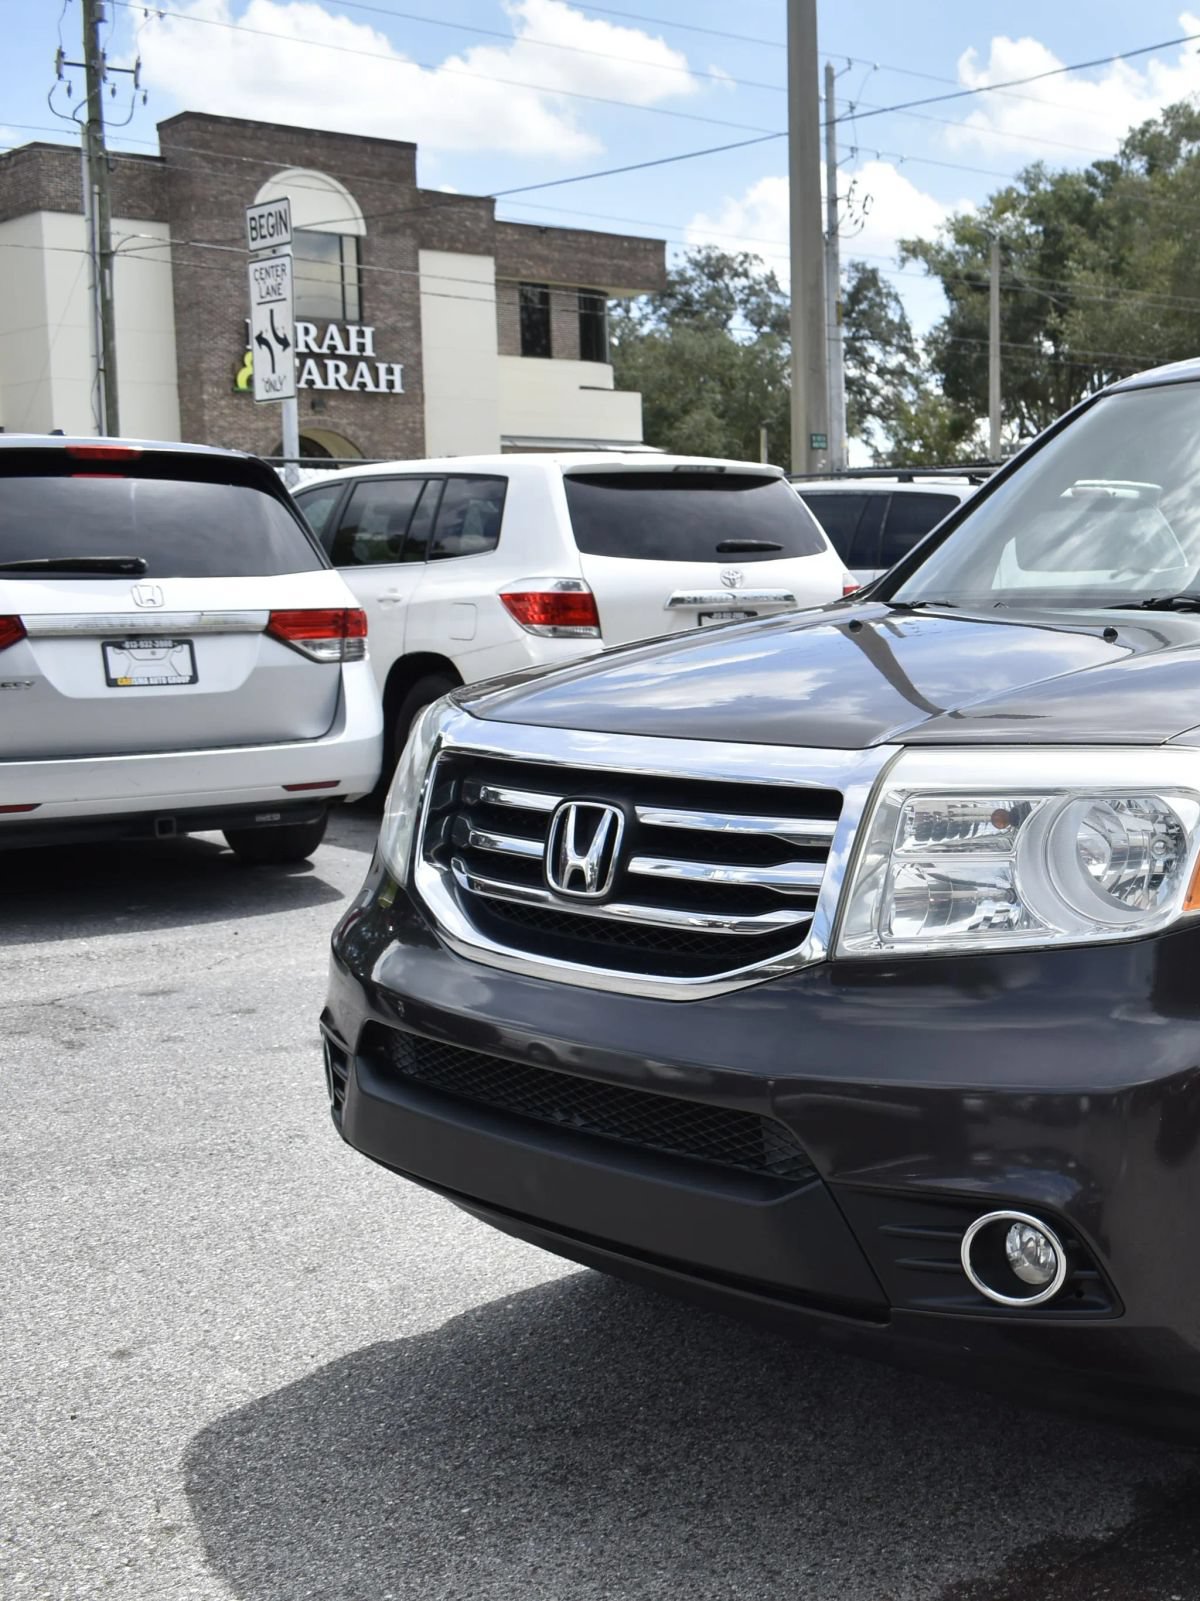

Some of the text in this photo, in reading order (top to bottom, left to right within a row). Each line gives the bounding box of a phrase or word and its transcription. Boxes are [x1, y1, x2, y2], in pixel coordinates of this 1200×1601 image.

[249, 208, 289, 242] BEGIN
[253, 263, 287, 282] CENTER
[258, 282, 283, 299] LANE
[245, 319, 375, 357] RAH
[295, 356, 405, 394] ARAH
